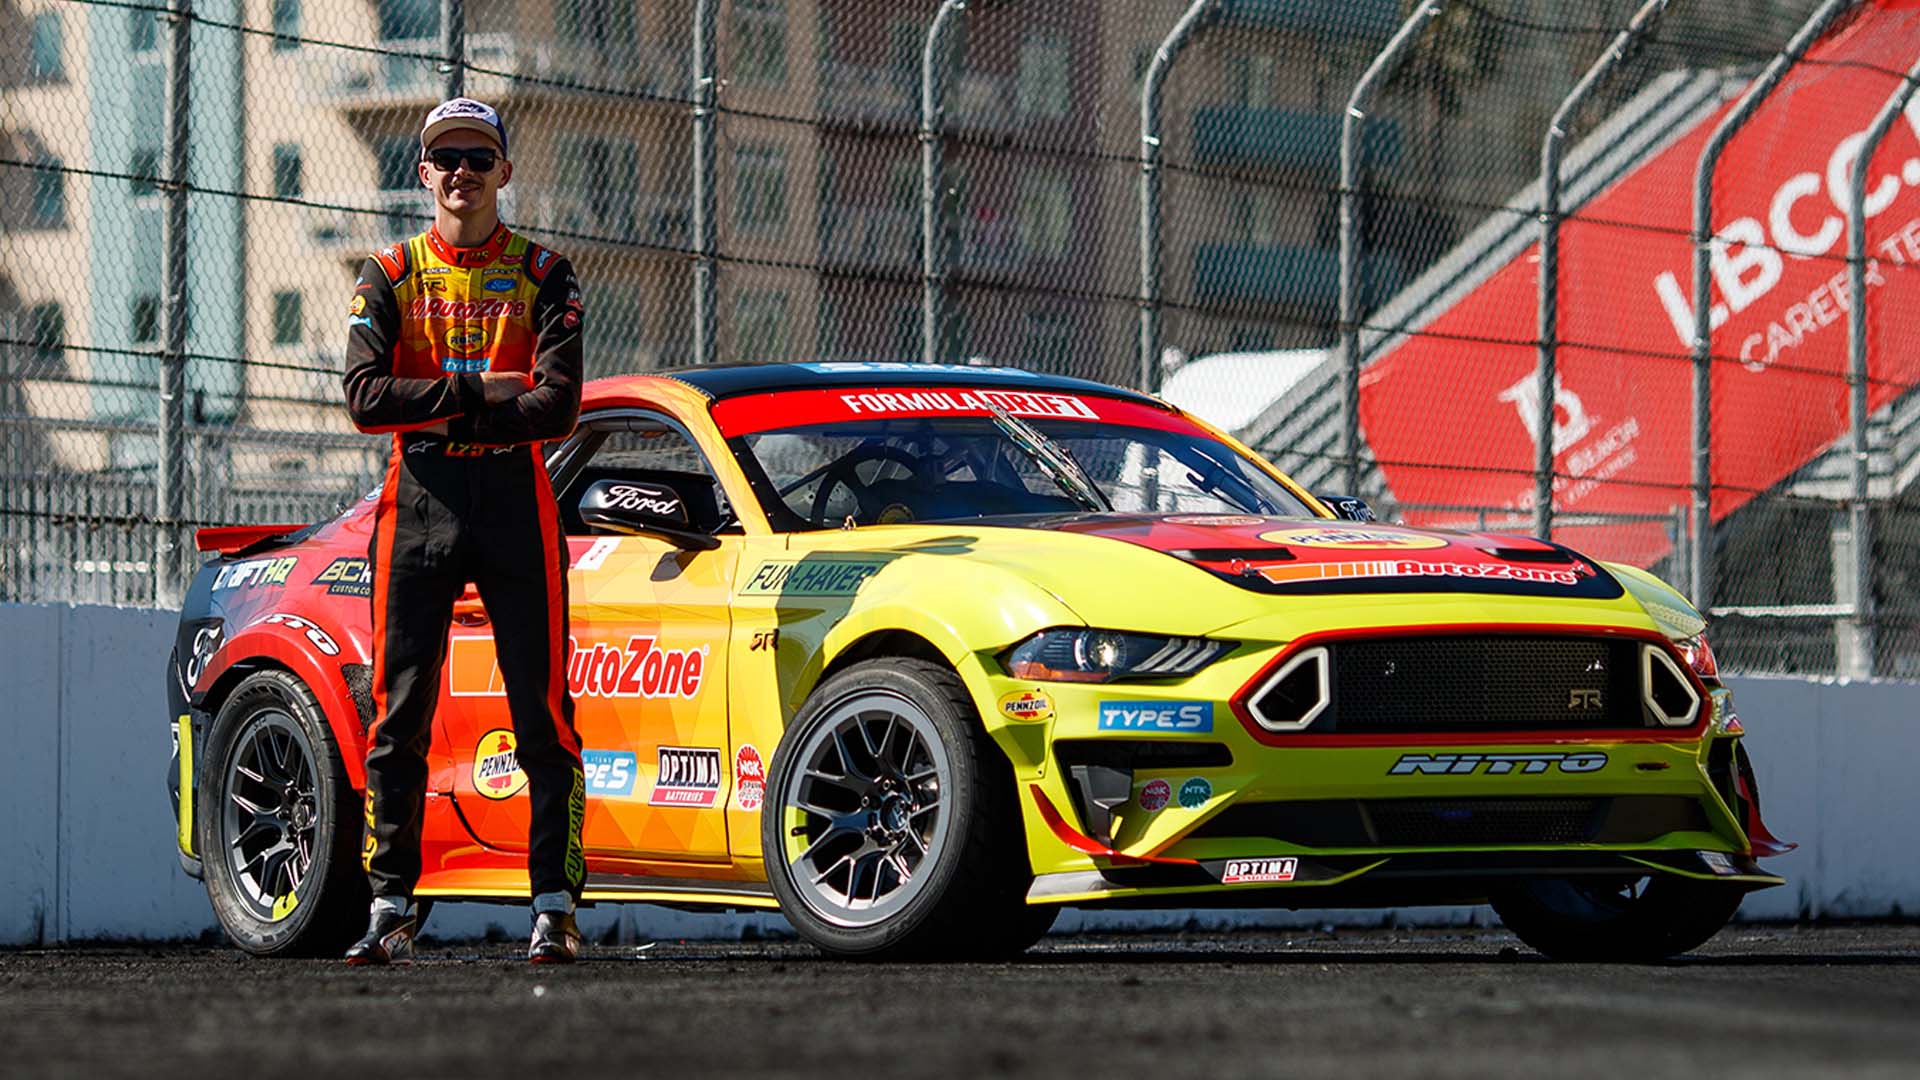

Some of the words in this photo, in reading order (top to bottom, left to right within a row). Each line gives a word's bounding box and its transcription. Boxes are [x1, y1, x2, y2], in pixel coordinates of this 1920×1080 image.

[600, 485, 680, 515] Ford
[569, 635, 702, 697] utoZone
[660, 754, 719, 783] OPTIMA
[740, 760, 761, 776] NGK
[1387, 752, 1608, 775] NITTO
[1228, 860, 1292, 877] OPTIMA
